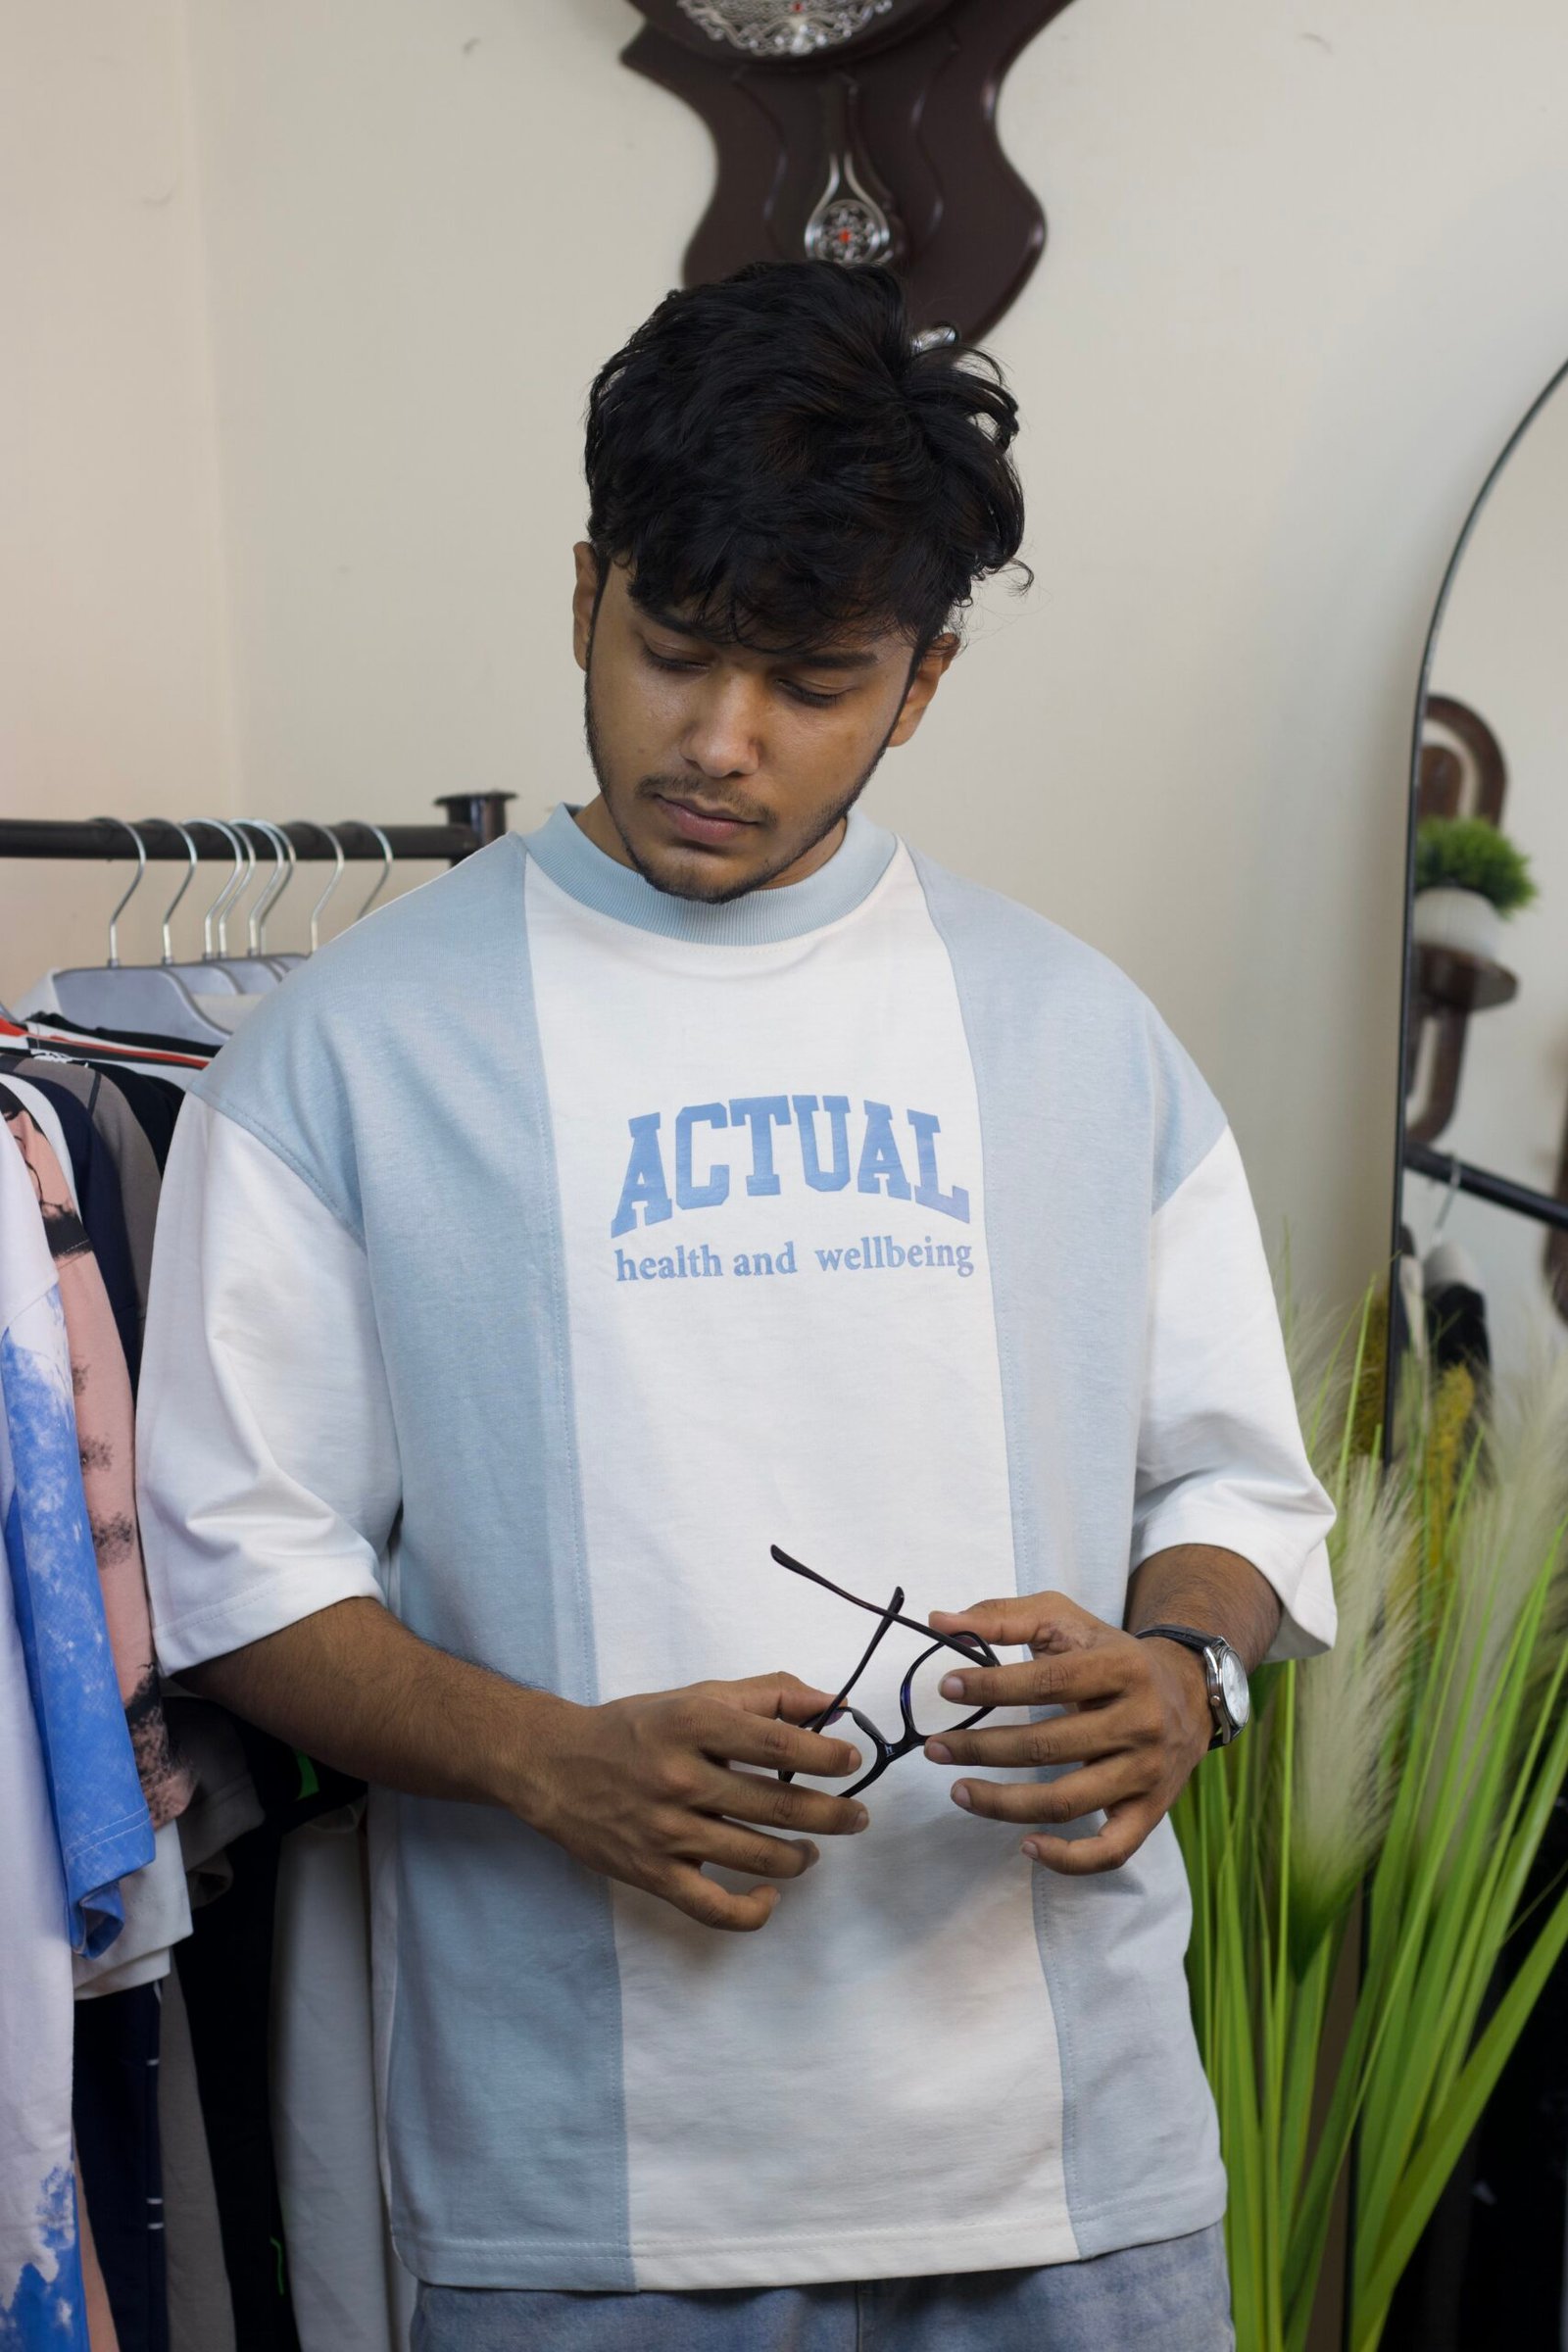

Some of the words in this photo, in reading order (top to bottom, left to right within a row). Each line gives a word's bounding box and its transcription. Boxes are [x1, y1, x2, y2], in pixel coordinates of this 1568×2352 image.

[611, 1095, 970, 1239] ACTUAL
[614, 1245, 723, 1282] health
[732, 1241, 798, 1276] and
[814, 1235, 974, 1278] wellbeing
